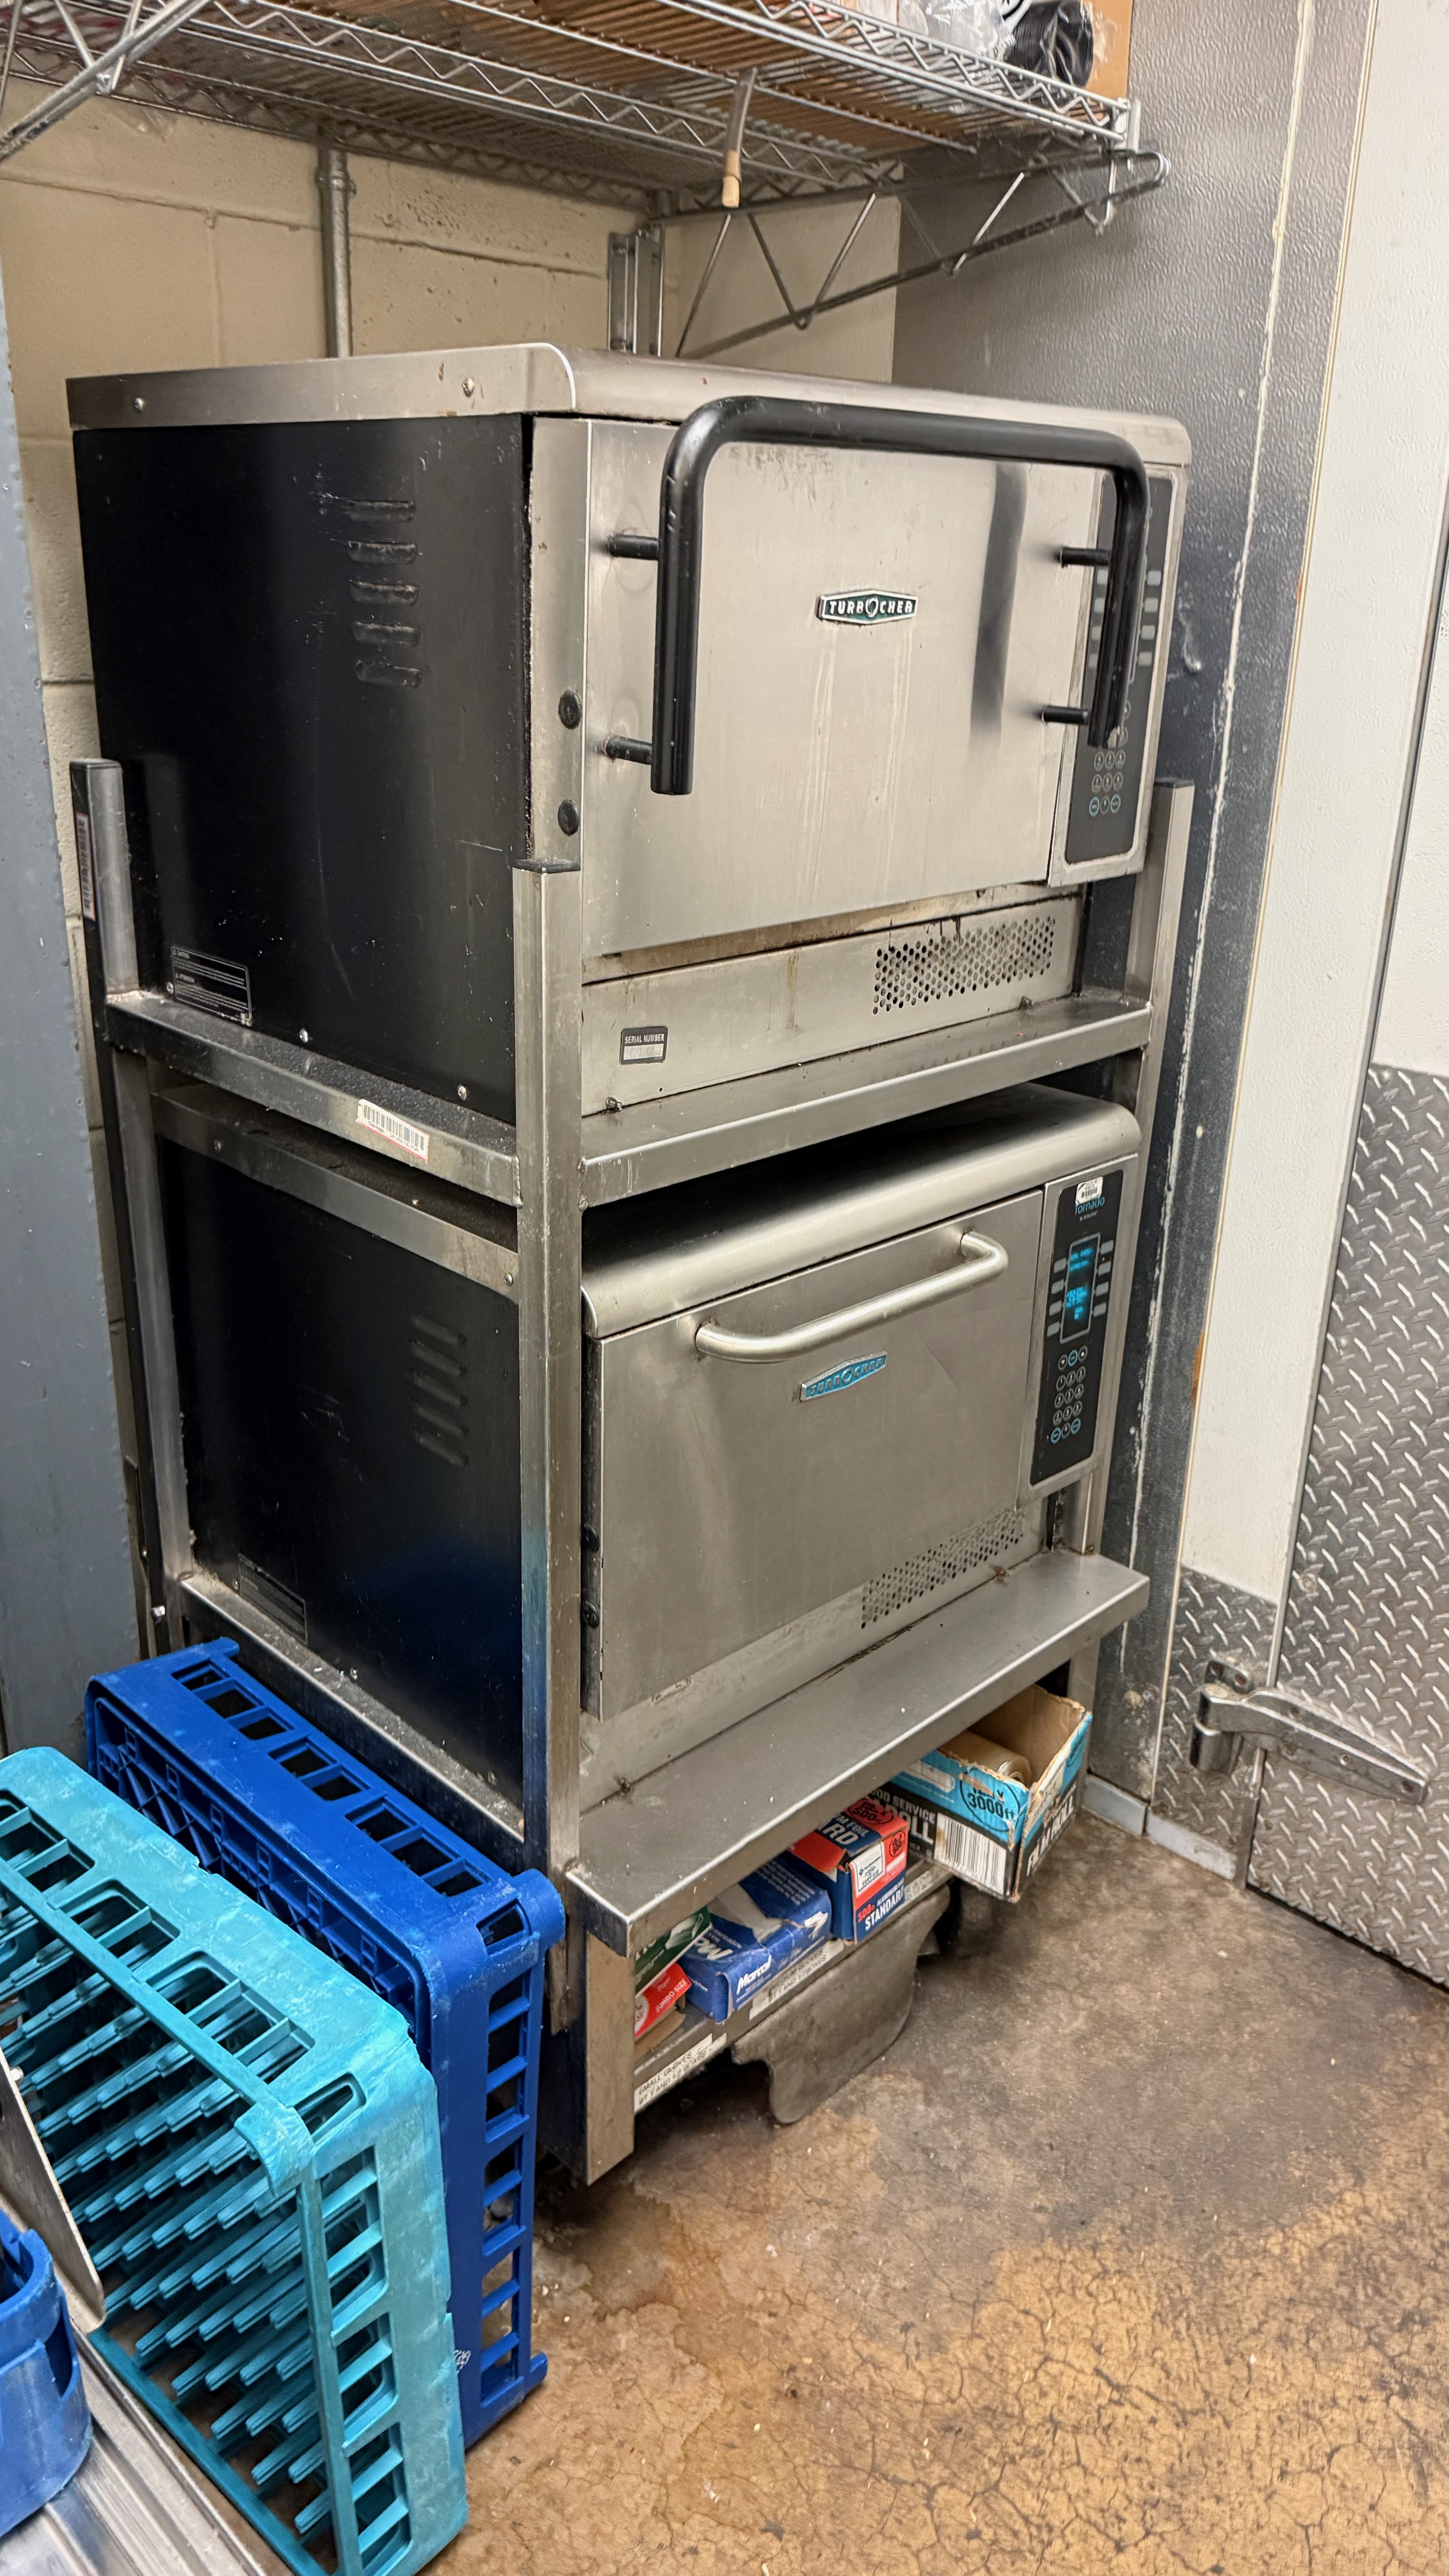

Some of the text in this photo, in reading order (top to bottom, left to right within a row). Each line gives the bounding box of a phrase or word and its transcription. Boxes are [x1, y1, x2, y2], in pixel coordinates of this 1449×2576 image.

[829, 596, 913, 618] TURBOCHEF
[625, 1034, 664, 1044] SERIAL NUMBER
[892, 1795, 936, 1826] SERVICE
[673, 1978, 688, 1993] SIZE
[638, 2052, 692, 2094] SMALL GLOVES
